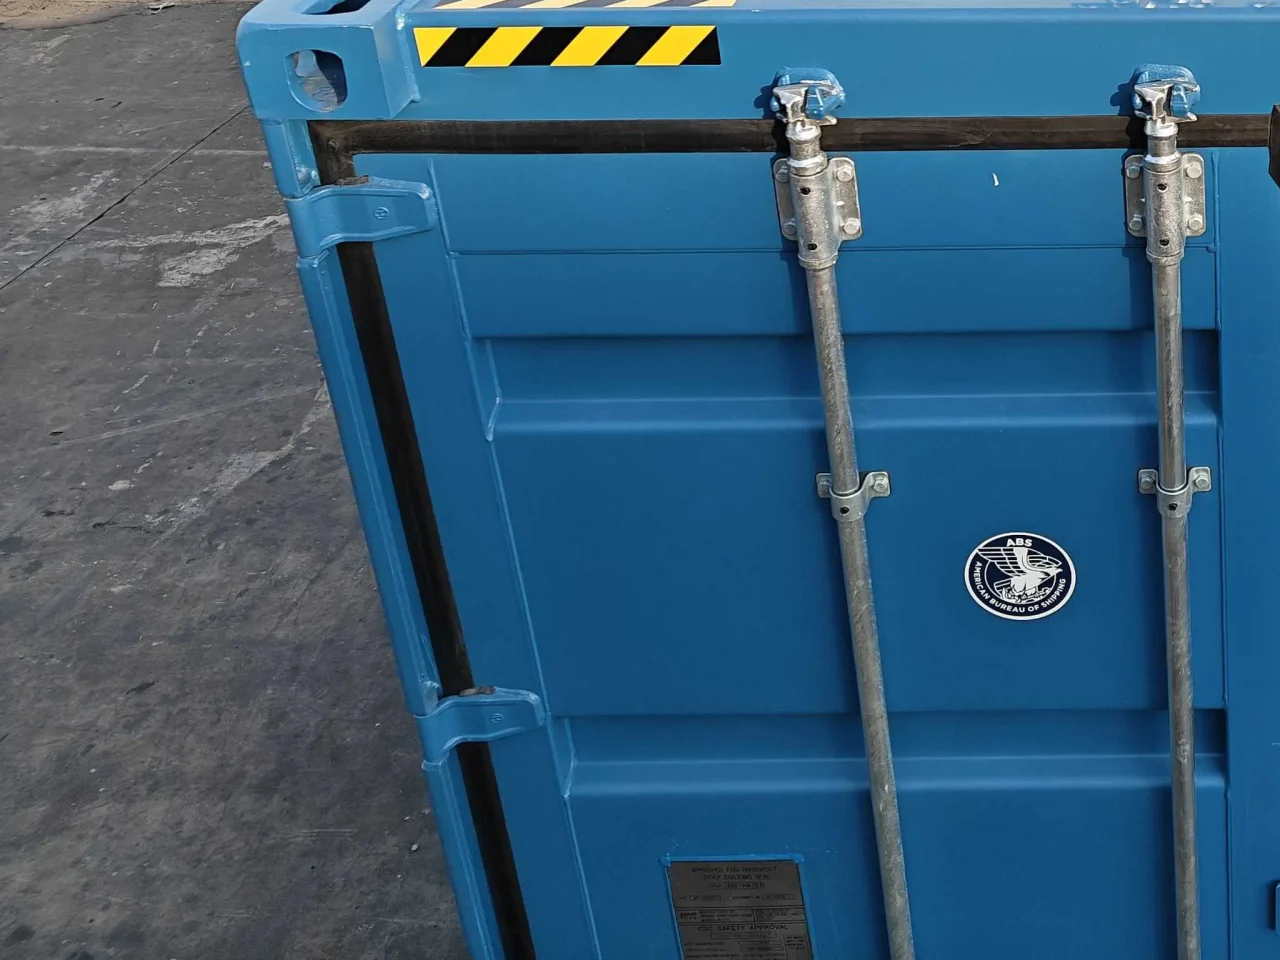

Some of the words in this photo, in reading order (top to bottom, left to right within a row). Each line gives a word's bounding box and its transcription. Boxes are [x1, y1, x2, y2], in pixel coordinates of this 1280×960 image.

[1006, 537, 1033, 547] ABS
[973, 561, 991, 600] AMERICAN
[989, 598, 1025, 613] BUREAU
[1027, 603, 1040, 612] OF
[1041, 578, 1066, 608] SHIPPING
